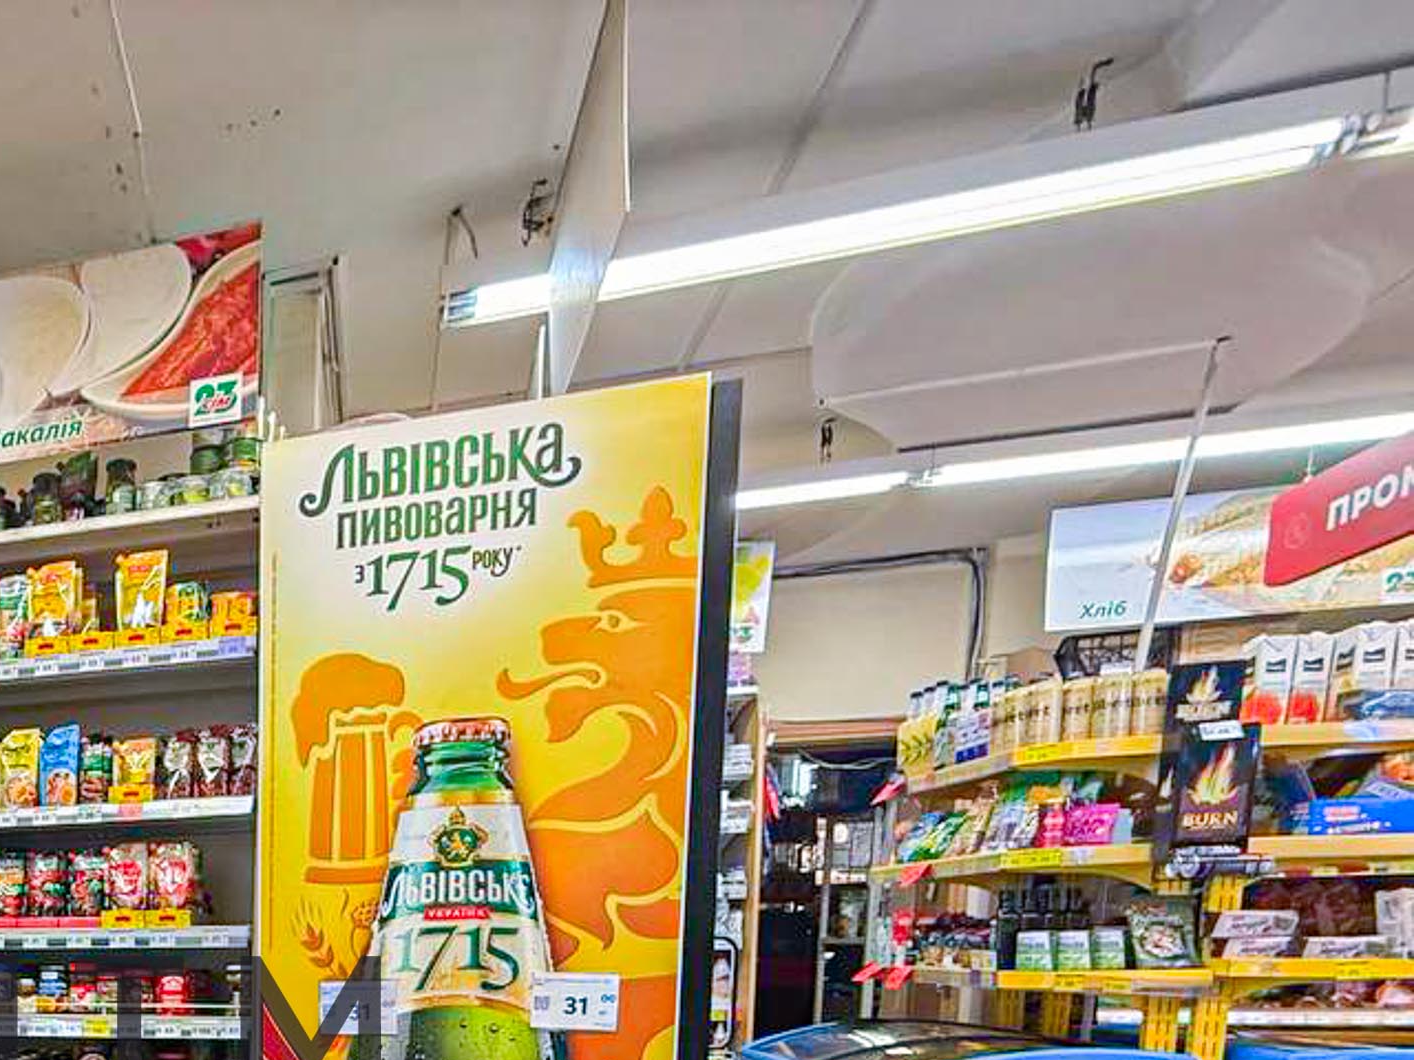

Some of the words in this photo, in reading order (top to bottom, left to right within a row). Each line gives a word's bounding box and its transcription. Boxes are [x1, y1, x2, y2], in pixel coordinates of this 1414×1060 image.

[335, 488, 538, 550] ПИВОВАРНЯ
[366, 545, 474, 612] 1715
[1079, 600, 1127, 621] Хліб
[1182, 811, 1238, 828] BURN
[394, 926, 522, 992] 1715
[563, 996, 588, 1015] 31
